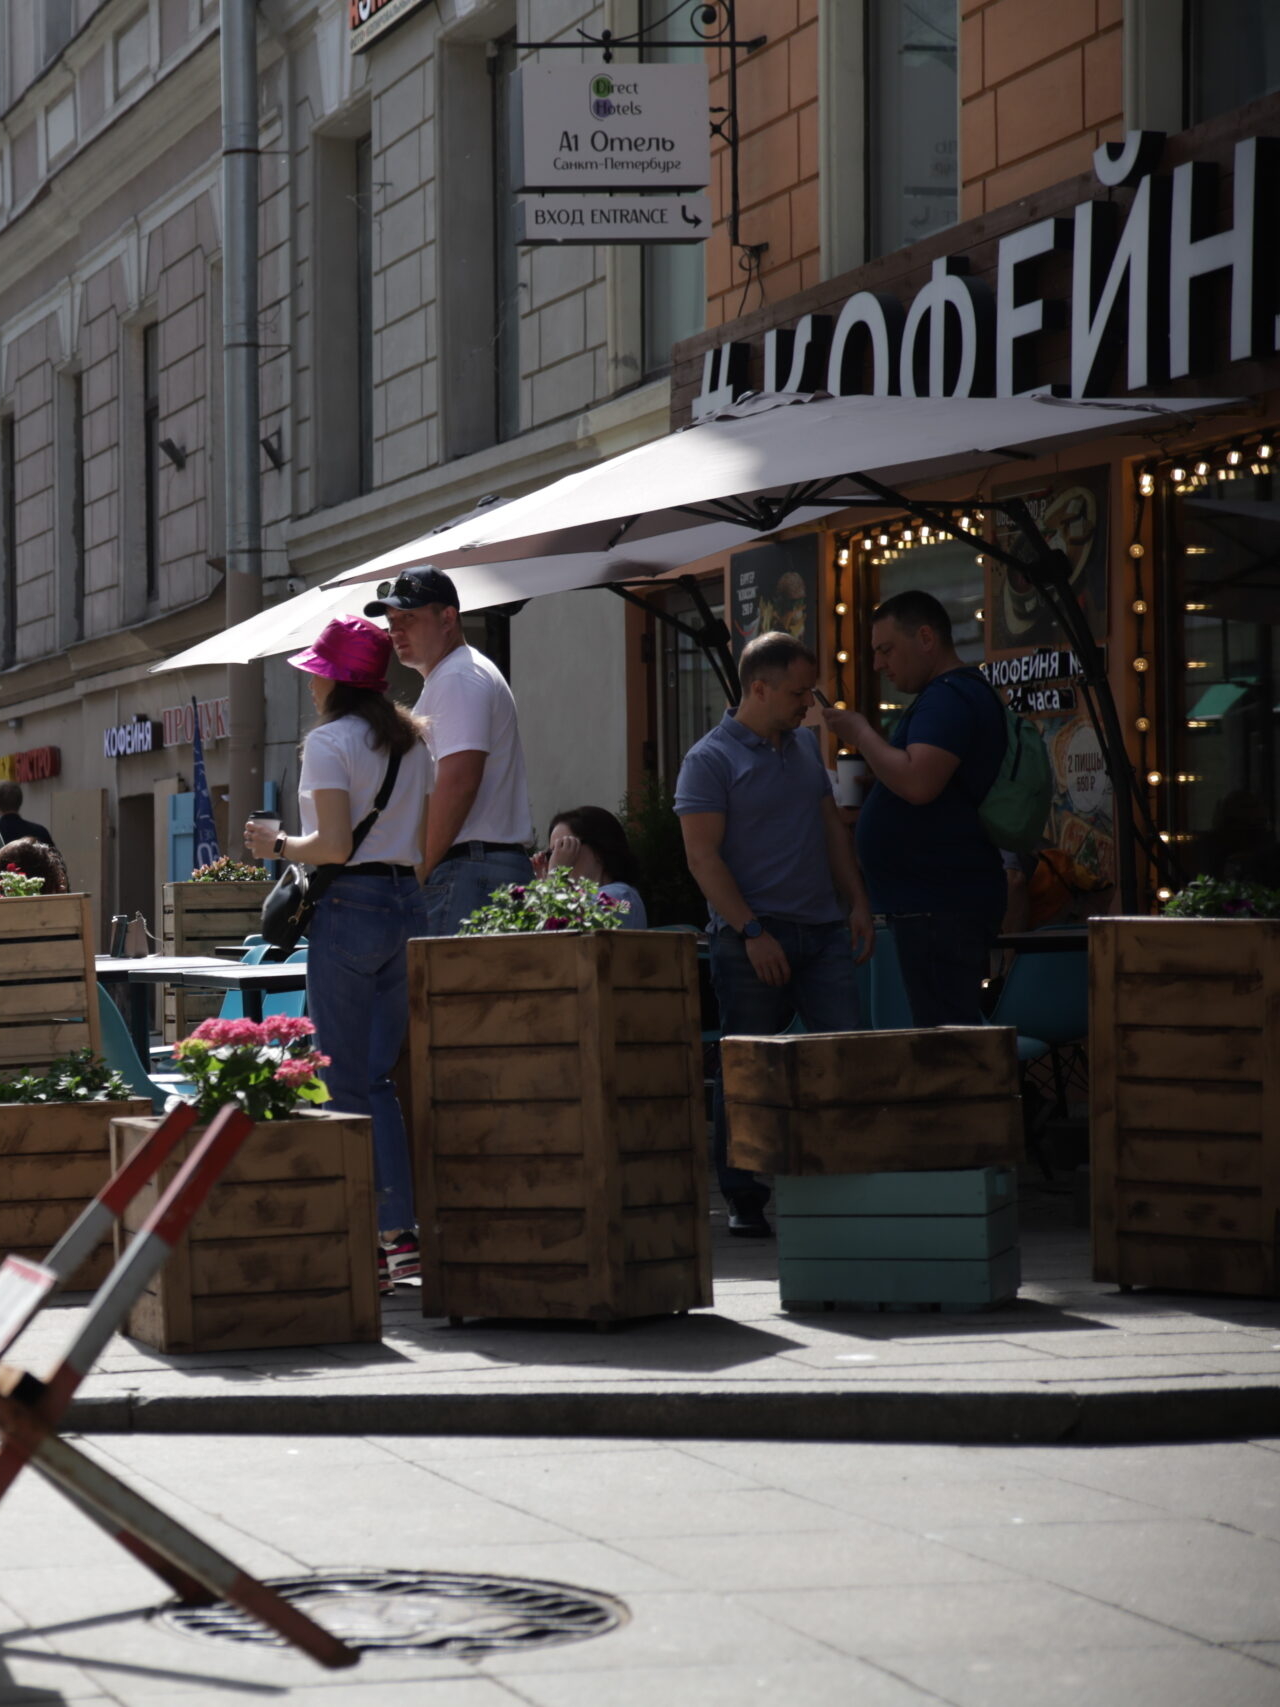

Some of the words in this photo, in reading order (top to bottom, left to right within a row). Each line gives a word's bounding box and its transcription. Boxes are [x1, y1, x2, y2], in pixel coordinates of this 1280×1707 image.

[596, 79, 638, 95] Direct
[596, 101, 642, 115] Hotels
[591, 130, 675, 152] Отель
[553, 157, 681, 173] Санкт-Петербург
[535, 209, 584, 225] ВХОД
[591, 208, 668, 224] ENTRANCE
[692, 131, 1280, 421] ОФЕЙН
[104, 714, 153, 757] КОФЕЙНЯ
[1068, 754, 1073, 773] 2
[1075, 752, 1104, 773] ПИЦЦЫ
